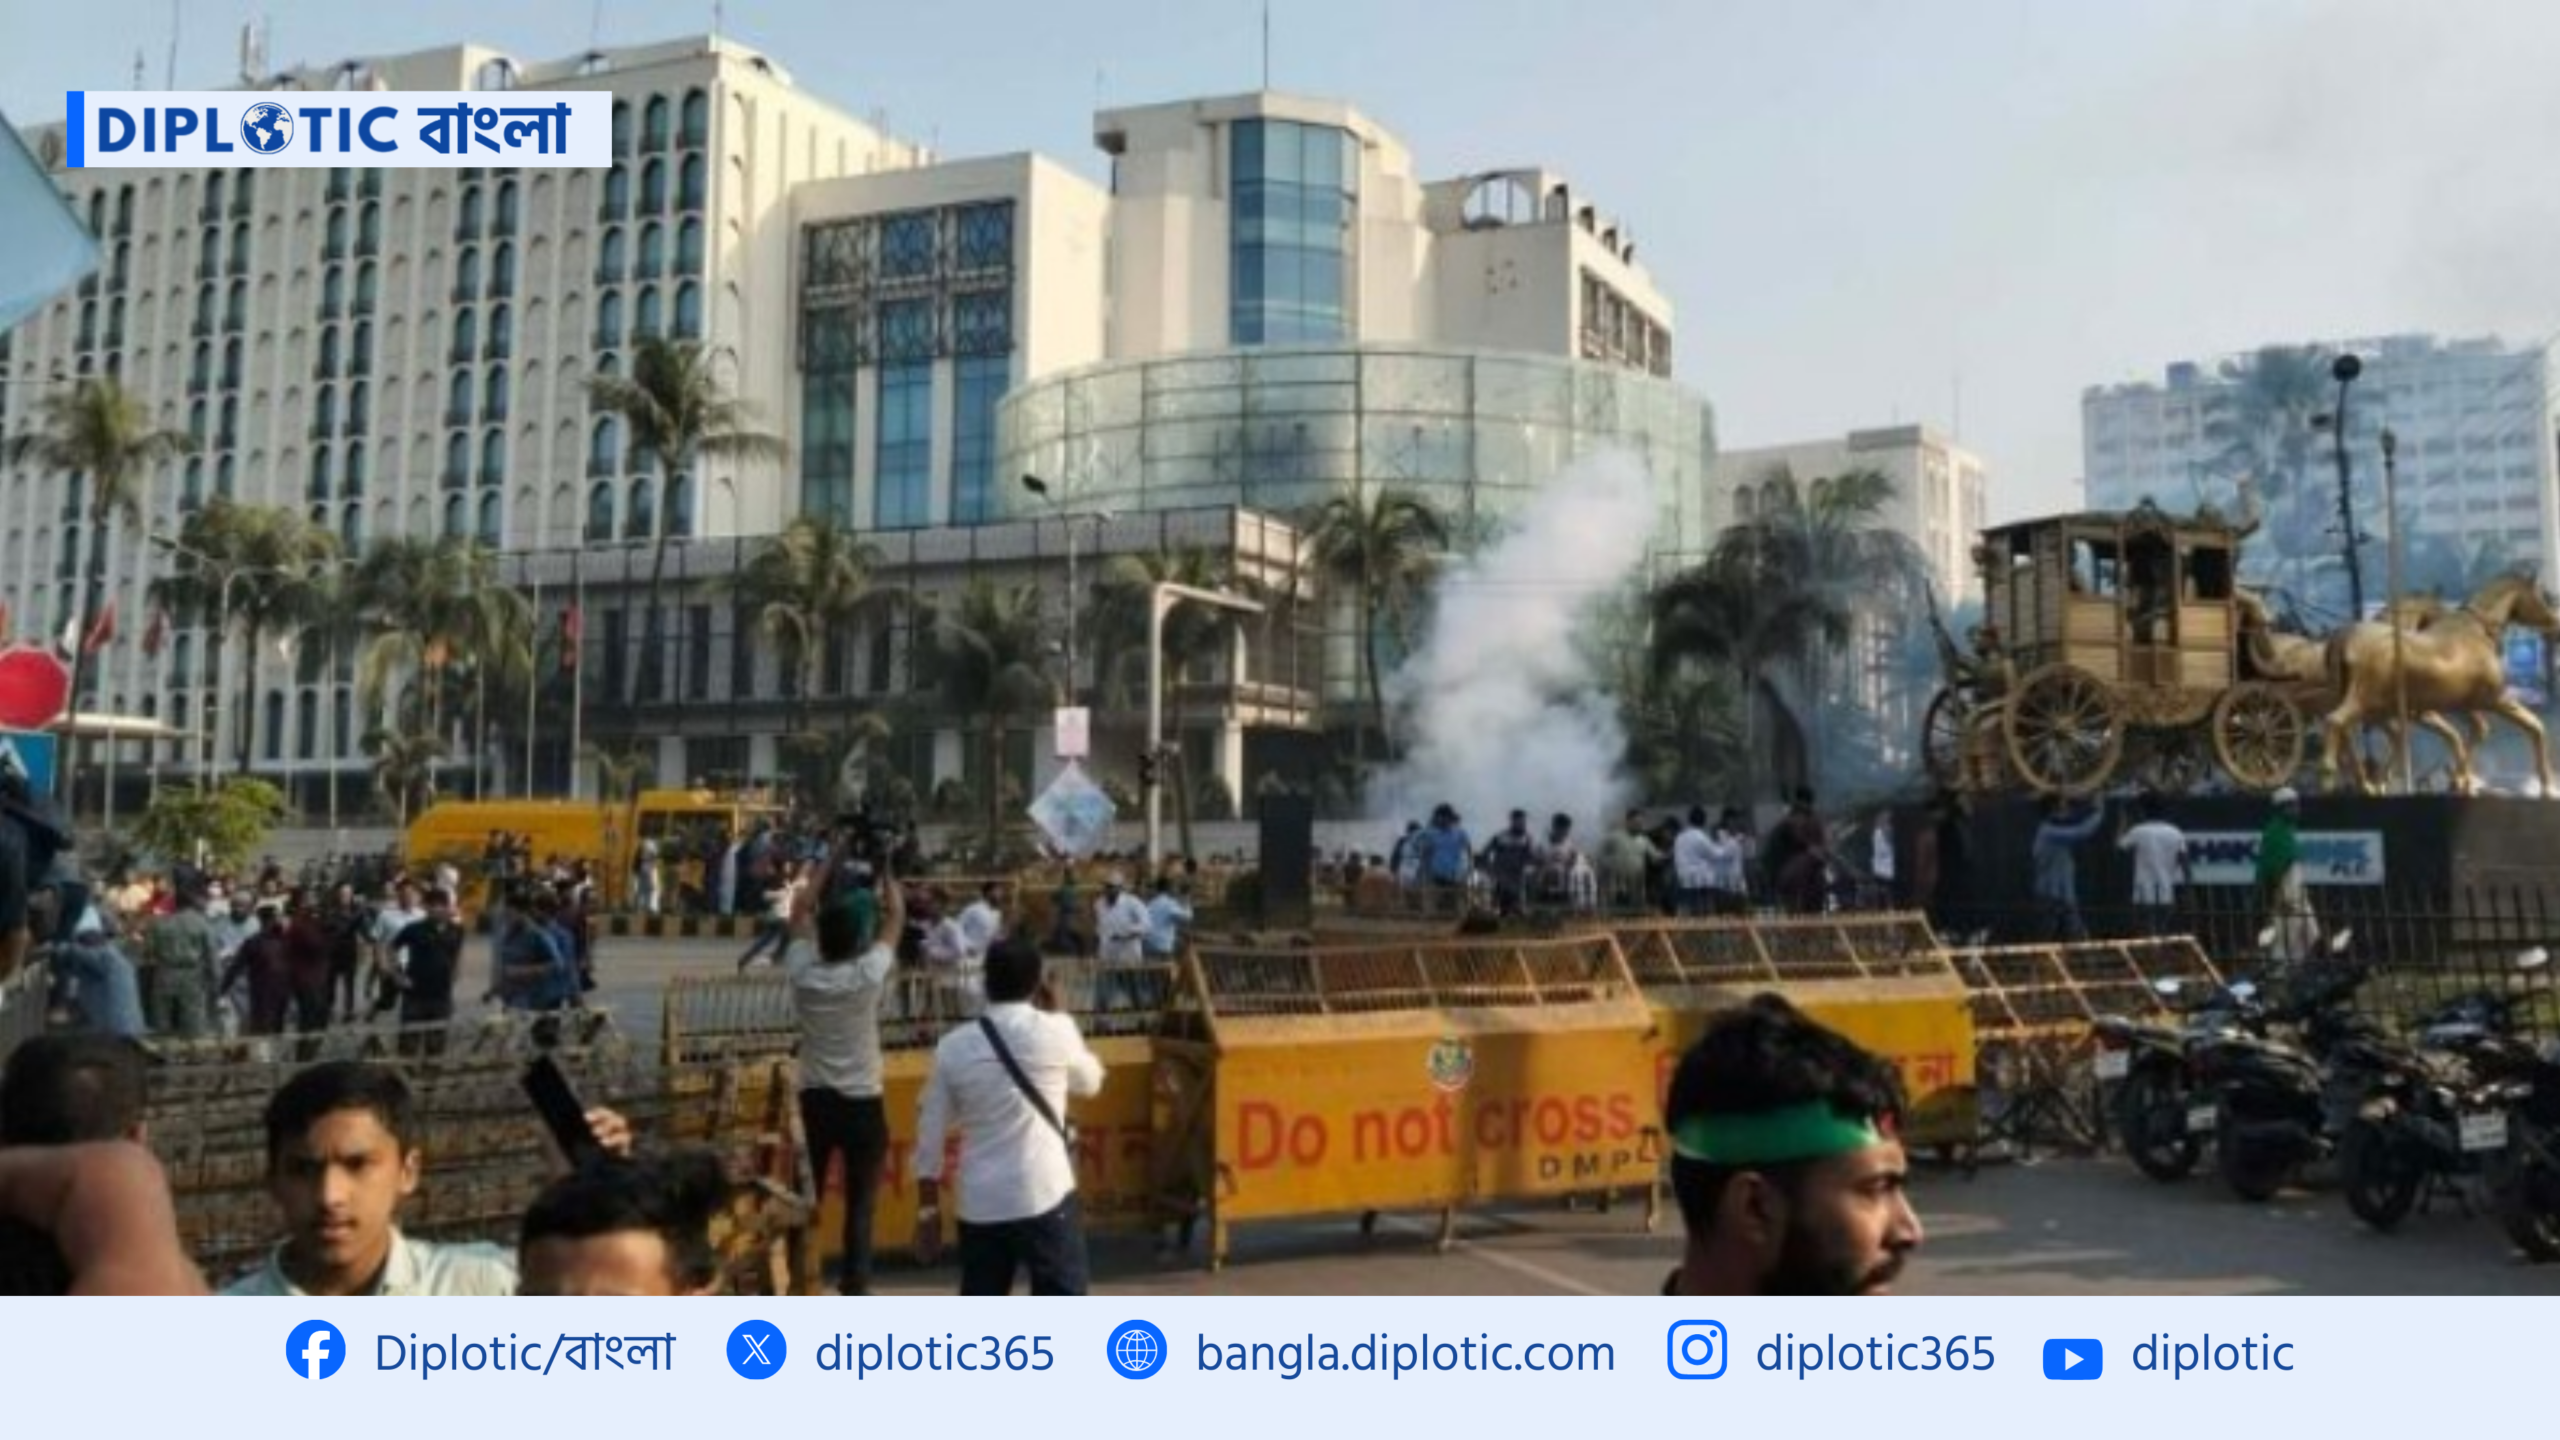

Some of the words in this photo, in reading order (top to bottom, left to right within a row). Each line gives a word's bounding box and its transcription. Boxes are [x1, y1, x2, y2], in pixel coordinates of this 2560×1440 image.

[1238, 1100, 1328, 1170] Do
[1353, 1093, 1455, 1163] not
[1475, 1092, 1636, 1151] cross
